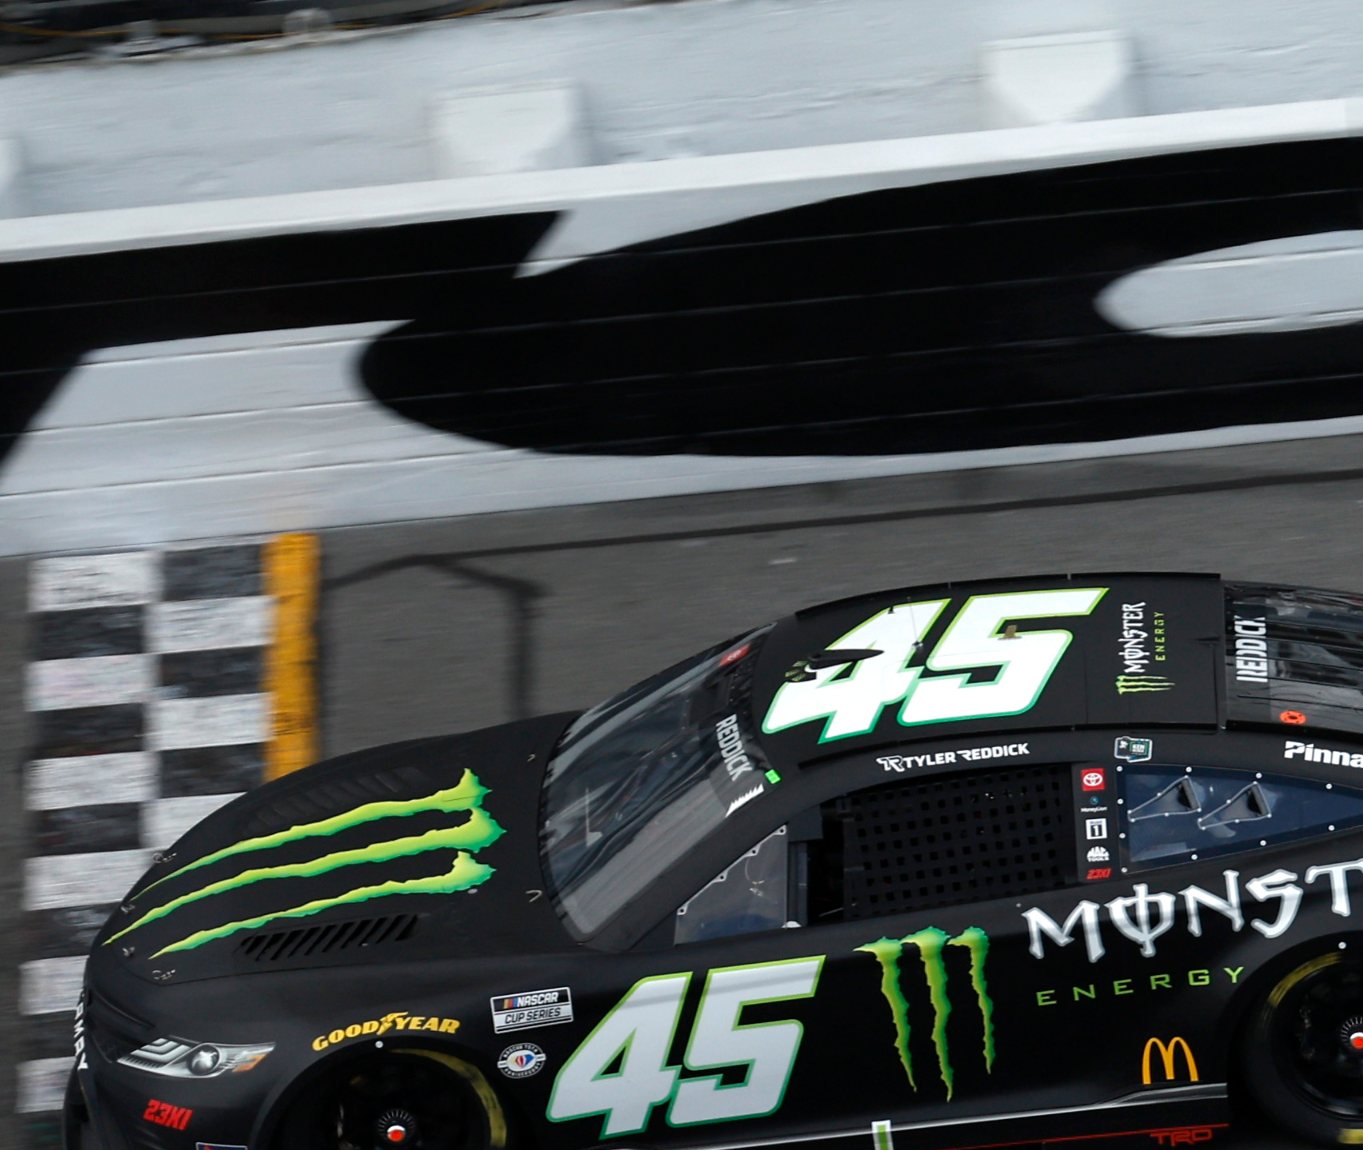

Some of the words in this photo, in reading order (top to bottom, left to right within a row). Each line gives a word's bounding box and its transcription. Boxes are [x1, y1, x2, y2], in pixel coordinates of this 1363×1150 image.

[1119, 601, 1150, 674] MONSTER
[1154, 610, 1166, 662] ENERGY
[760, 587, 1109, 745] 45
[715, 713, 752, 782] REDDICK
[902, 751, 956, 769] TYLER
[956, 742, 1030, 761] REDDICK
[517, 992, 559, 1007] NASCAR
[1037, 966, 1244, 1006] ENERGY
[312, 1012, 461, 1051] GOODYEAR
[505, 1012, 525, 1024] CUP
[526, 1007, 561, 1021] SERIES
[546, 954, 827, 1140] 45
[143, 1099, 193, 1131] 23XI
